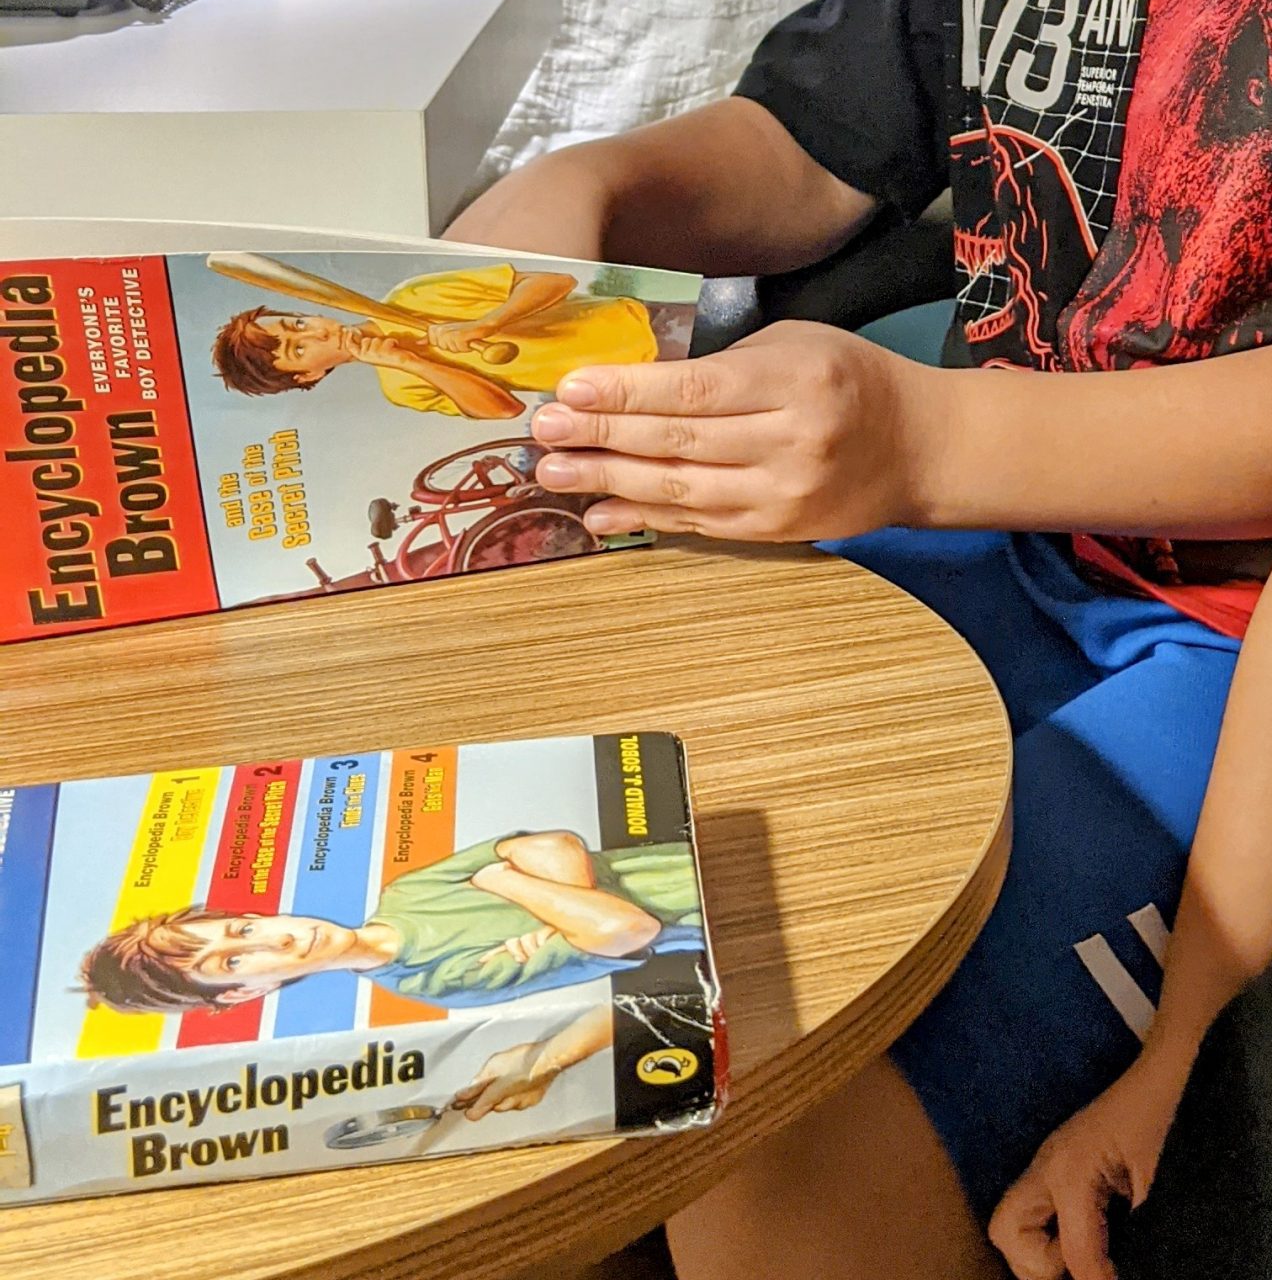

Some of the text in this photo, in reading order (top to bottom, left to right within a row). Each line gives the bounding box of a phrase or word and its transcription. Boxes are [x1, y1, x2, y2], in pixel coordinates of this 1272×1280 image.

[78, 287, 112, 394] EVERYONE'S
[103, 296, 131, 379] FAVORITE
[122, 268, 158, 401] BOY DETECTIVE
[0, 273, 105, 626] Encyclopedia
[105, 409, 182, 579] Brown
[217, 472, 245, 529] and the
[241, 443, 278, 541] Case of the
[268, 428, 312, 550] Secret Pitch
[134, 775, 200, 888] Encyclopedia Brown 1
[223, 765, 283, 880] Encyclopedia Brown 2
[257, 800, 283, 828] Secret
[263, 780, 287, 801] Pitch
[309, 759, 359, 872] Encyclopedia Brown 3
[393, 753, 438, 863] Encyclopedia Brown 4
[620, 735, 648, 836] DONALD J. SOBOL
[250, 846, 275, 870] Case
[95, 1040, 425, 1135] Encyclopedia
[129, 1122, 289, 1178] Brown
